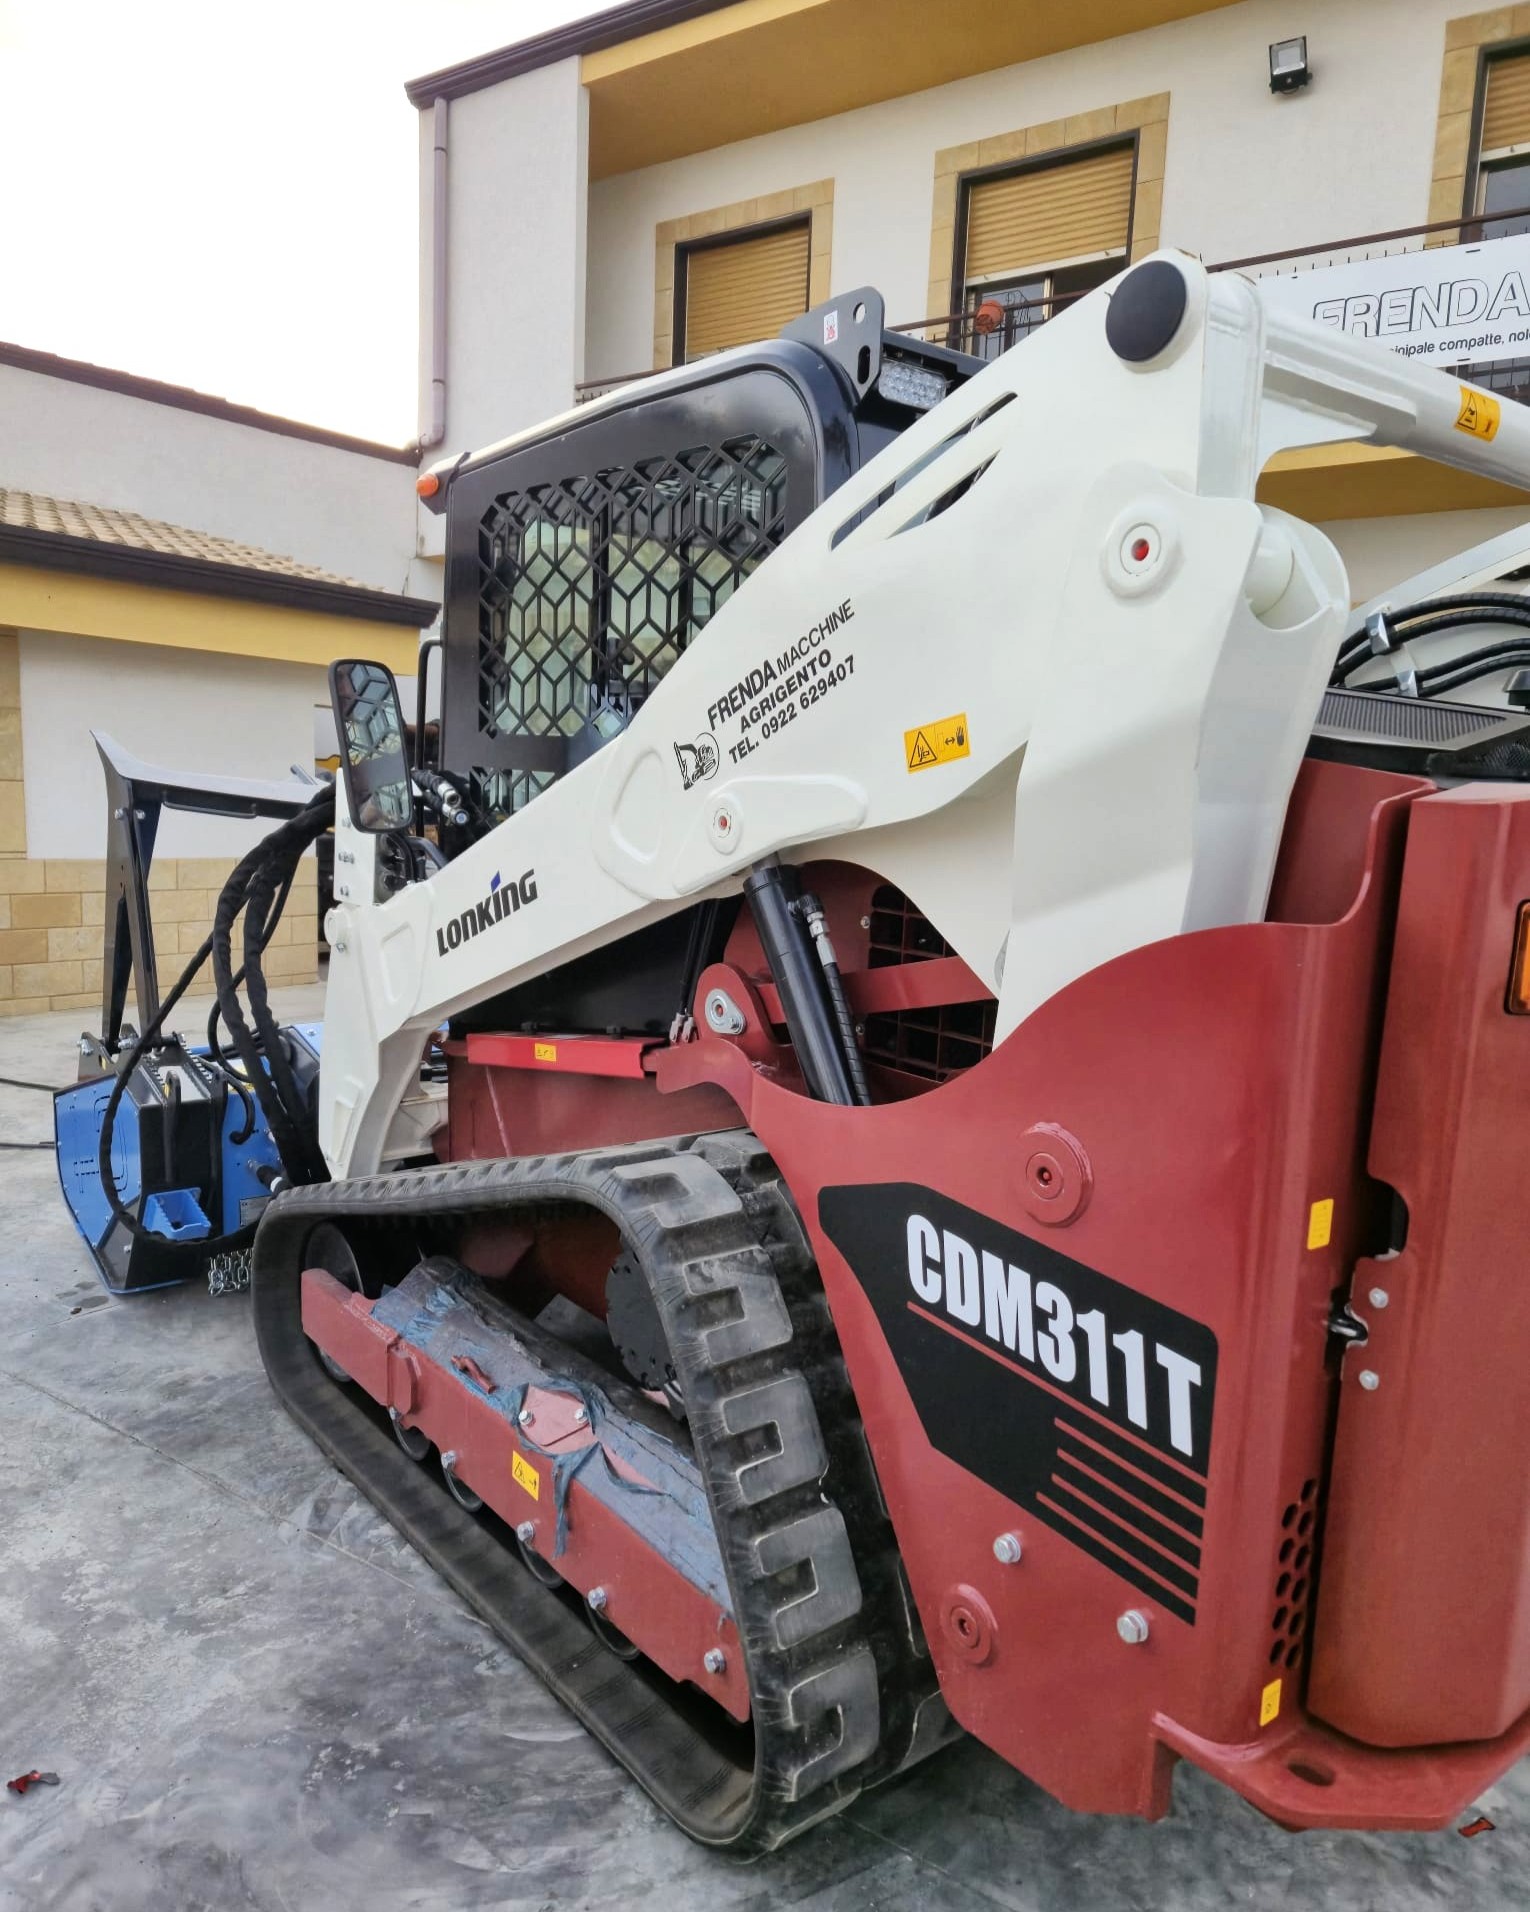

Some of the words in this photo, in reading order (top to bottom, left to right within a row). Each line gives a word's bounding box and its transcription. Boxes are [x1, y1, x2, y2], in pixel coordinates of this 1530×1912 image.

[1313, 271, 1530, 337] FRENDA
[1390, 341, 1435, 357] inipale
[1439, 333, 1505, 351] compatte,
[1508, 328, 1530, 343] nol
[707, 659, 779, 731] FRENDA
[776, 598, 856, 675] MACCHINE
[728, 733, 760, 764] TEL.
[761, 703, 798, 740] 0922
[800, 655, 856, 711] 629407
[739, 648, 832, 734] AGRIGENTO
[906, 1213, 1202, 1458] CDM311T
